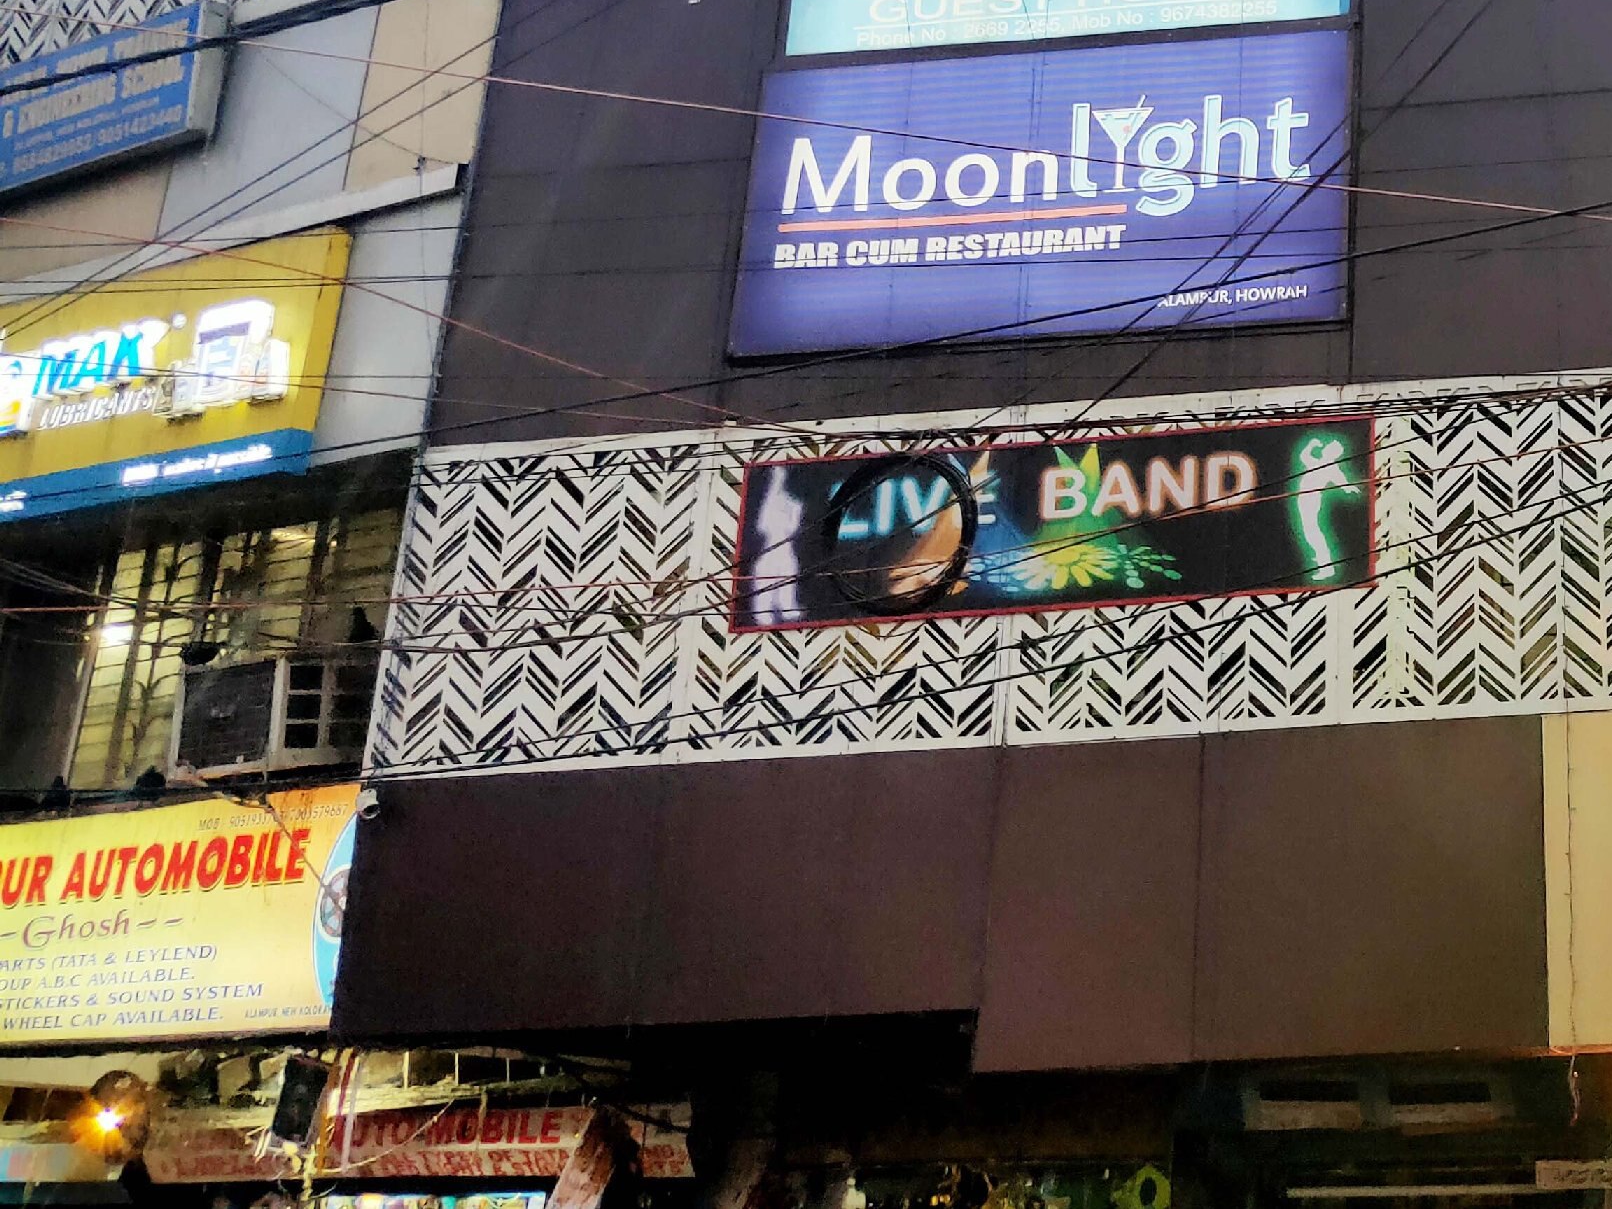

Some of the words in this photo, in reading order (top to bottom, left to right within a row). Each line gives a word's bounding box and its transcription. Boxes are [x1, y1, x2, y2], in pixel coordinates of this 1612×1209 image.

[856, 28, 915, 48] Phone
[921, 26, 946, 43] No
[1072, 13, 1111, 32] Mob
[1117, 10, 1144, 27] No
[774, 236, 838, 269] BAR
[845, 234, 918, 266] CUM
[925, 224, 1126, 260] RESTAURANT
[1235, 285, 1308, 303] HOWRAH
[1038, 451, 1260, 522] BAND
[0, 854, 53, 908] UR
[59, 828, 312, 903] AUTOMOBILE
[23, 908, 131, 950] Ghosh
[52, 953, 97, 970] (TATA
[125, 945, 218, 963] LEYLEND)
[87, 966, 196, 987] AVAILABLE.
[106, 989, 175, 1005] SOUND
[180, 983, 264, 1001] SYSTEM
[4, 1015, 63, 1029] WHEEL
[71, 1013, 107, 1027] CAP
[112, 1006, 225, 1026] AVAILABLE.
[425, 1109, 562, 1146] MOBILE
